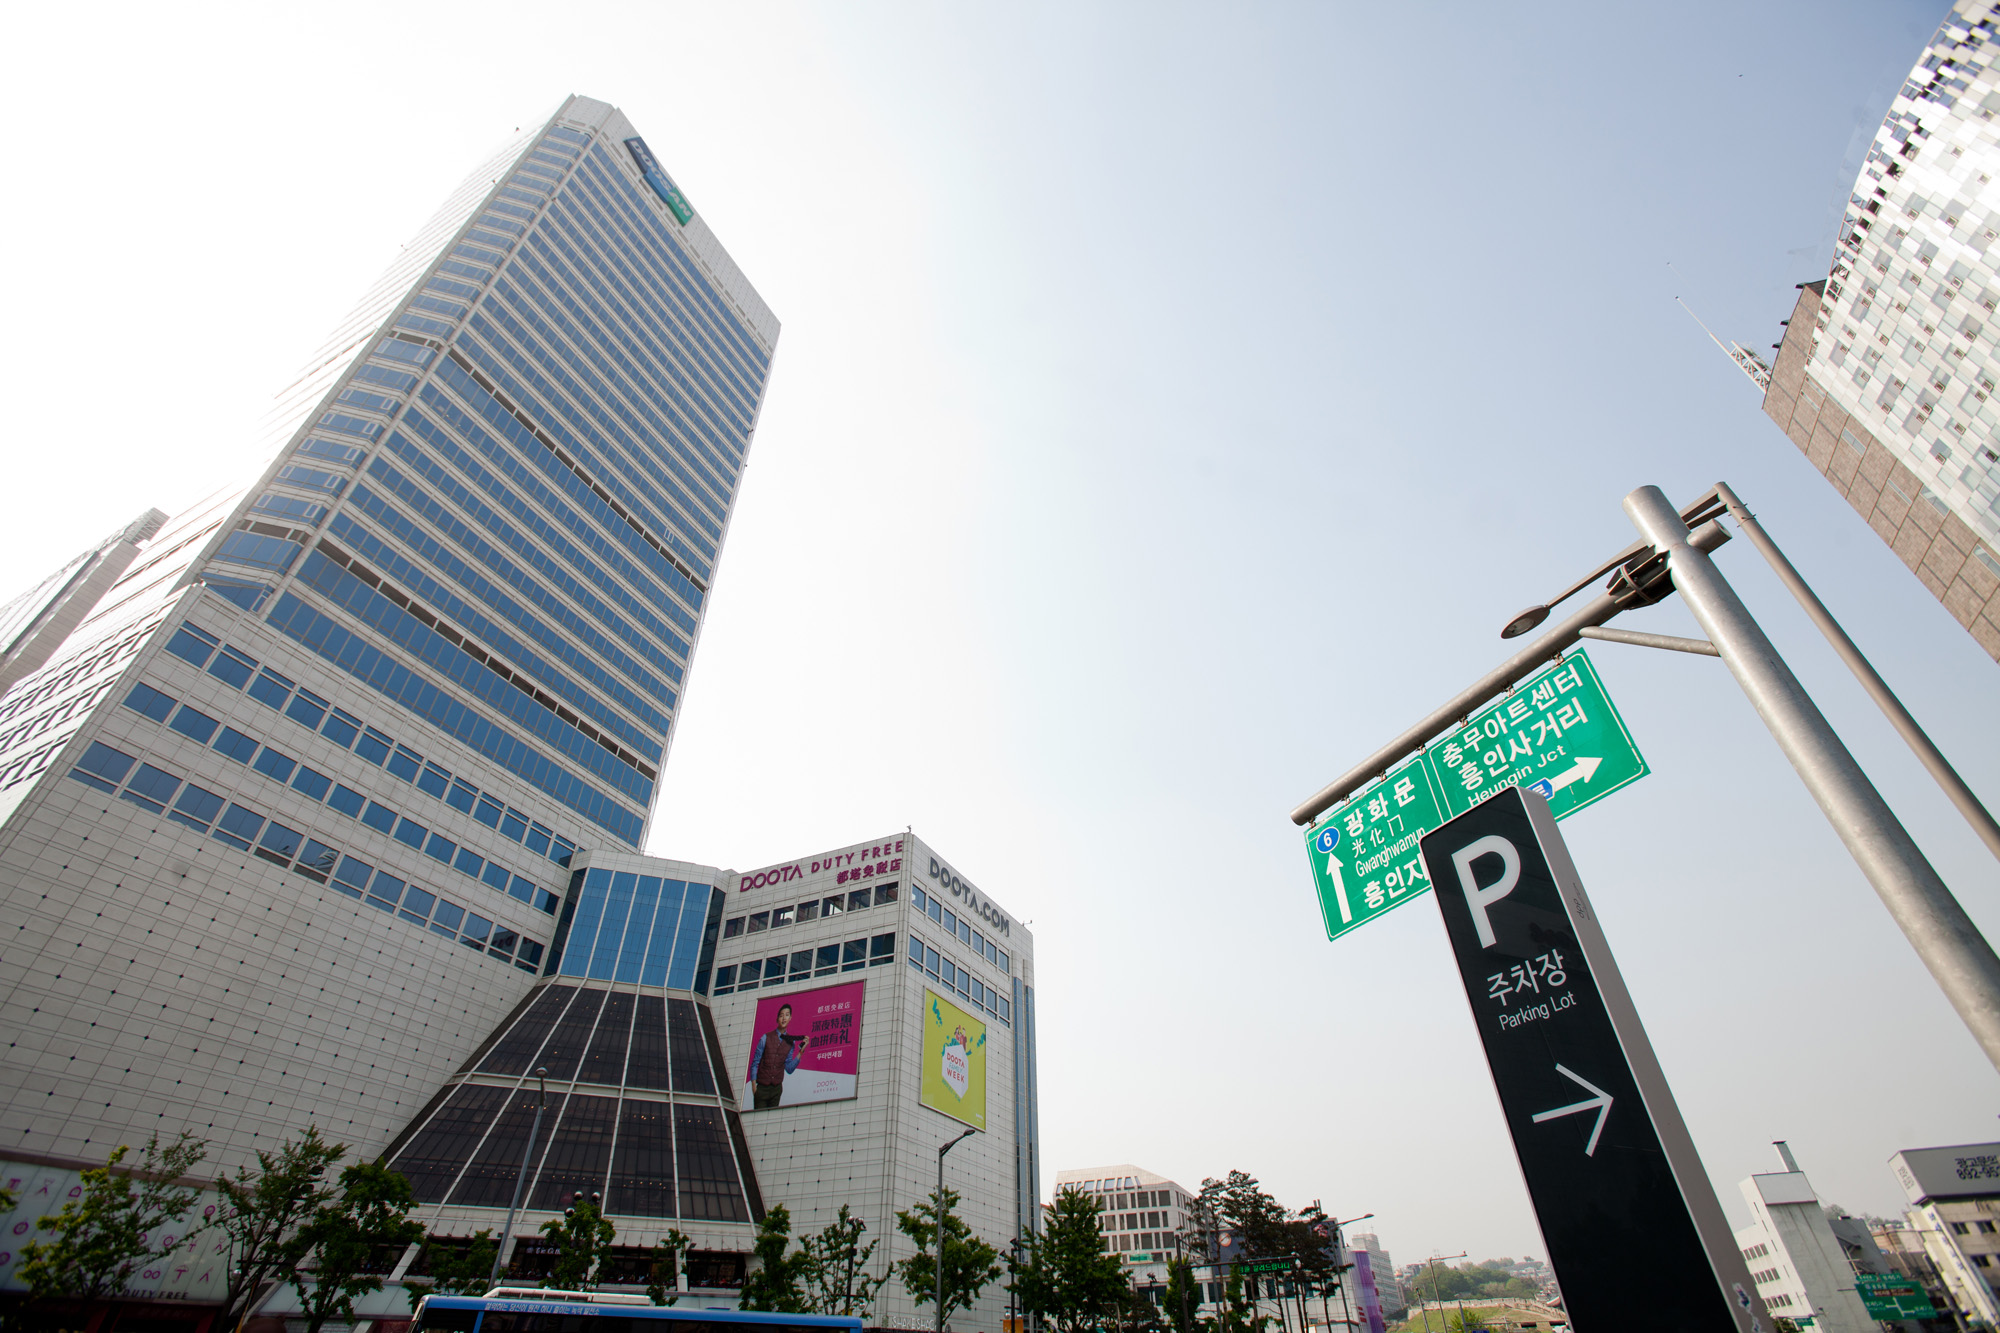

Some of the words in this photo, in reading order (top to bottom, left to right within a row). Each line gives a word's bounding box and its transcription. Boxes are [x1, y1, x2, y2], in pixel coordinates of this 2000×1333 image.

[630, 140, 691, 217] DOOSAN
[1441, 663, 1584, 769] 충무아트센터
[1458, 697, 1589, 792] 흥인사거리
[1467, 764, 1533, 807] Heungin
[1536, 744, 1567, 769] Jct
[1343, 775, 1416, 838] 광화문
[1323, 832, 1334, 848] 6
[1351, 814, 1405, 858] 光化门
[1355, 826, 1426, 878] Gwanghwamun
[740, 865, 803, 893] DOOTA
[811, 852, 856, 875] DUTY
[860, 840, 904, 861] FREE
[1451, 835, 1521, 949] P
[929, 856, 1010, 938] DOOTA.COM
[1487, 948, 1567, 1006] 주차장
[811, 1013, 853, 1033] 深夜特惠
[1498, 999, 1550, 1031] Parking
[1552, 990, 1577, 1013] Lot
[810, 1029, 852, 1048] 血拼有礼
[946, 1052, 966, 1069] DOOTA
[816, 1079, 837, 1088] DOOTA
[946, 1067, 965, 1084] WEEK
[123, 1288, 154, 1299] DUTY
[158, 1291, 189, 1300] FREE
